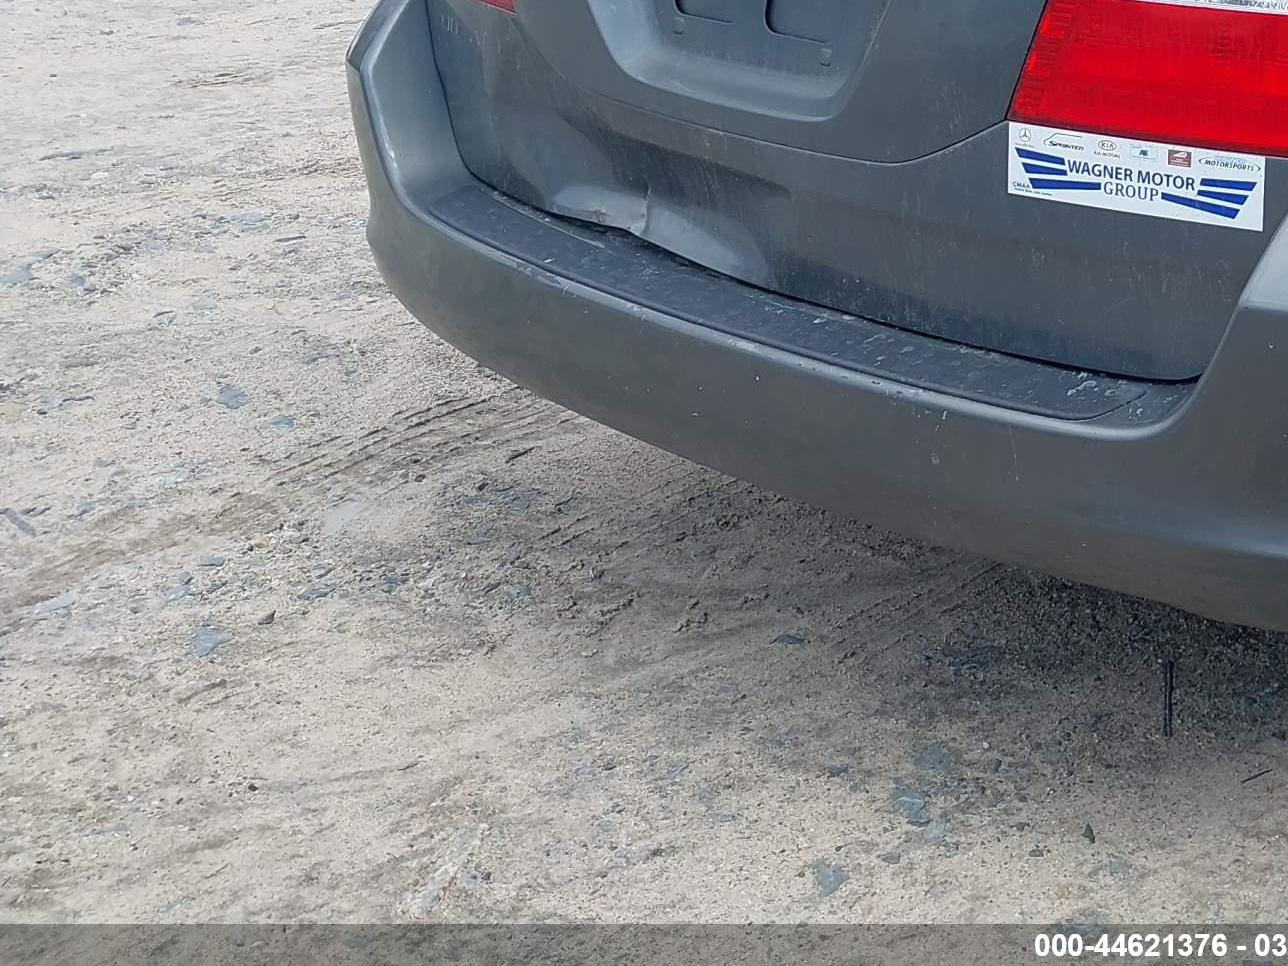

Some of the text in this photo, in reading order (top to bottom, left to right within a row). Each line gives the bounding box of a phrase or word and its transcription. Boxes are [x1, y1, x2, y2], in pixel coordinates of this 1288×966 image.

[1067, 159, 1195, 191] WAGNER MOTOR
[1204, 159, 1254, 172] MOTORSPORTS
[1103, 181, 1159, 202] GROUP
